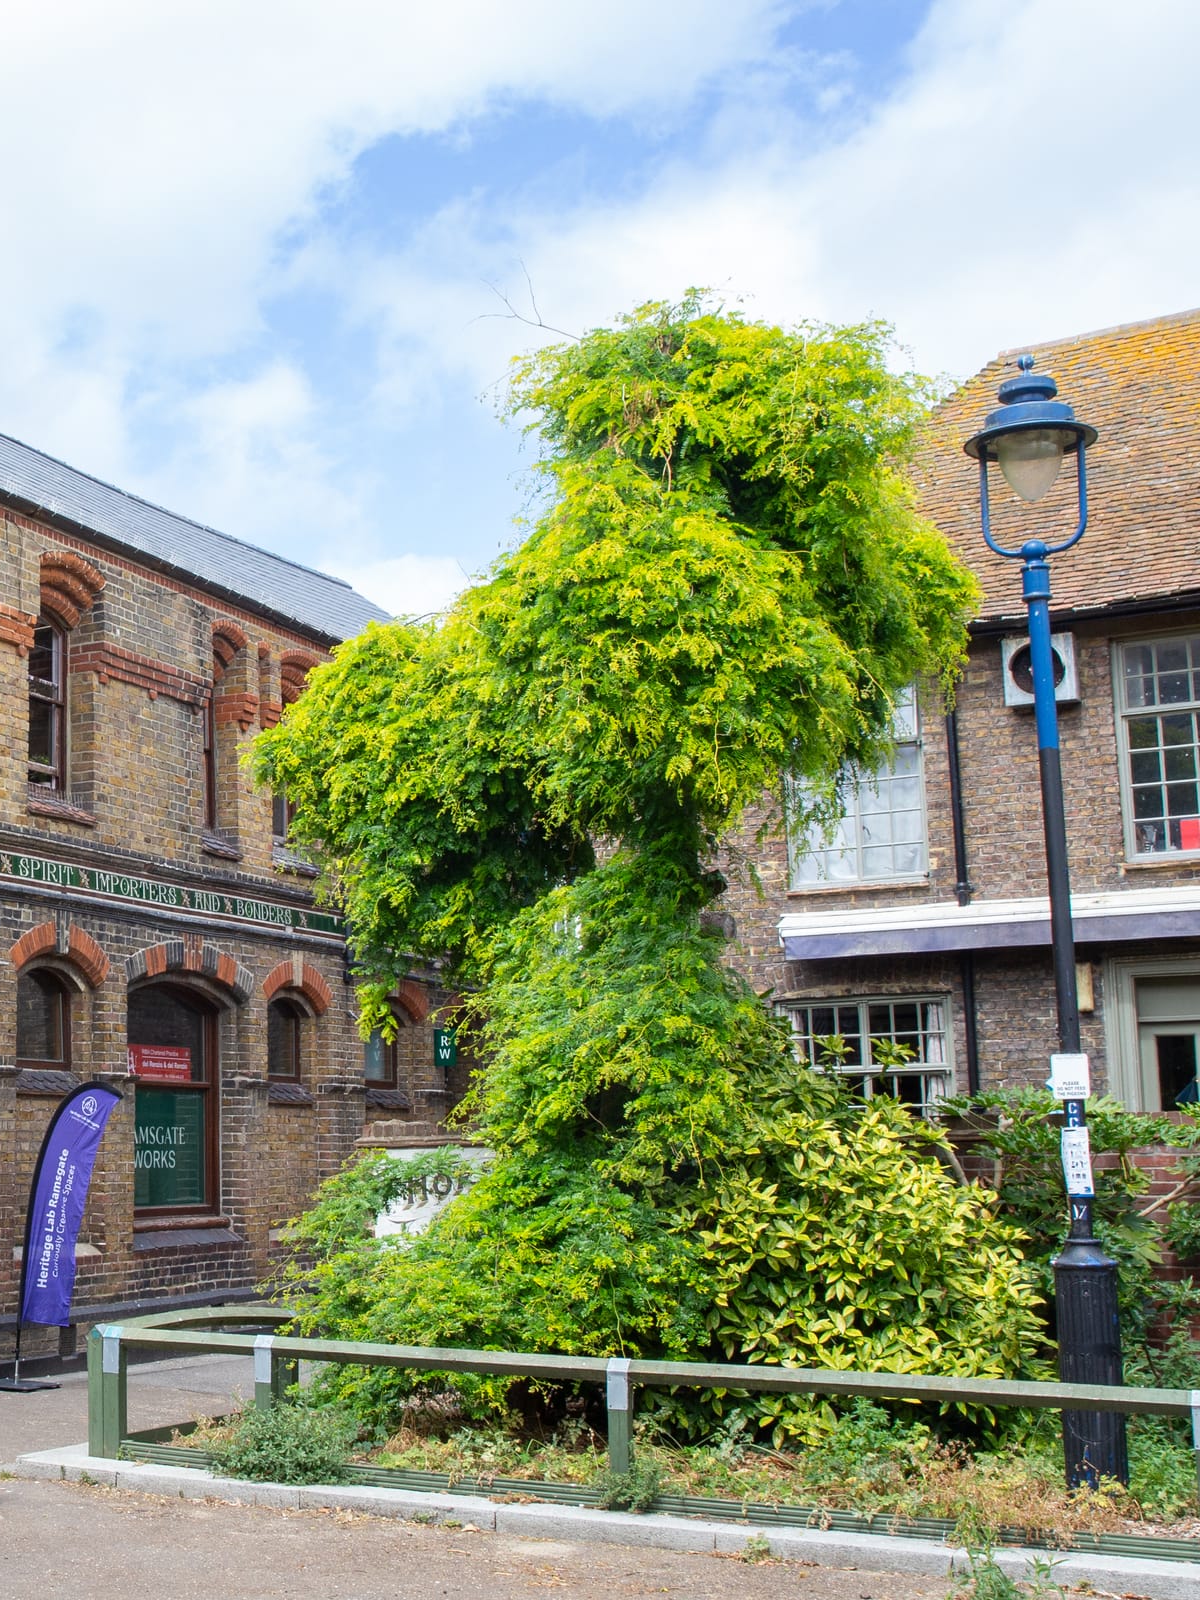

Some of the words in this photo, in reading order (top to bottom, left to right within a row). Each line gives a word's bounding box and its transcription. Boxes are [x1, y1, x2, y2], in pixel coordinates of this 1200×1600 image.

[18, 857, 74, 886] SPIRIT
[95, 872, 177, 906] IMPORTERS
[194, 891, 221, 913] AND
[236, 900, 292, 925] BONDERS
[48, 1148, 69, 1208] Ramsgate
[62, 1164, 76, 1194] Spaces
[134, 1150, 176, 1169] WORKS
[45, 1210, 55, 1233] Lab
[56, 1196, 68, 1234] Creative
[36, 1234, 54, 1288] Heritage
[52, 1236, 65, 1278] Curiously
